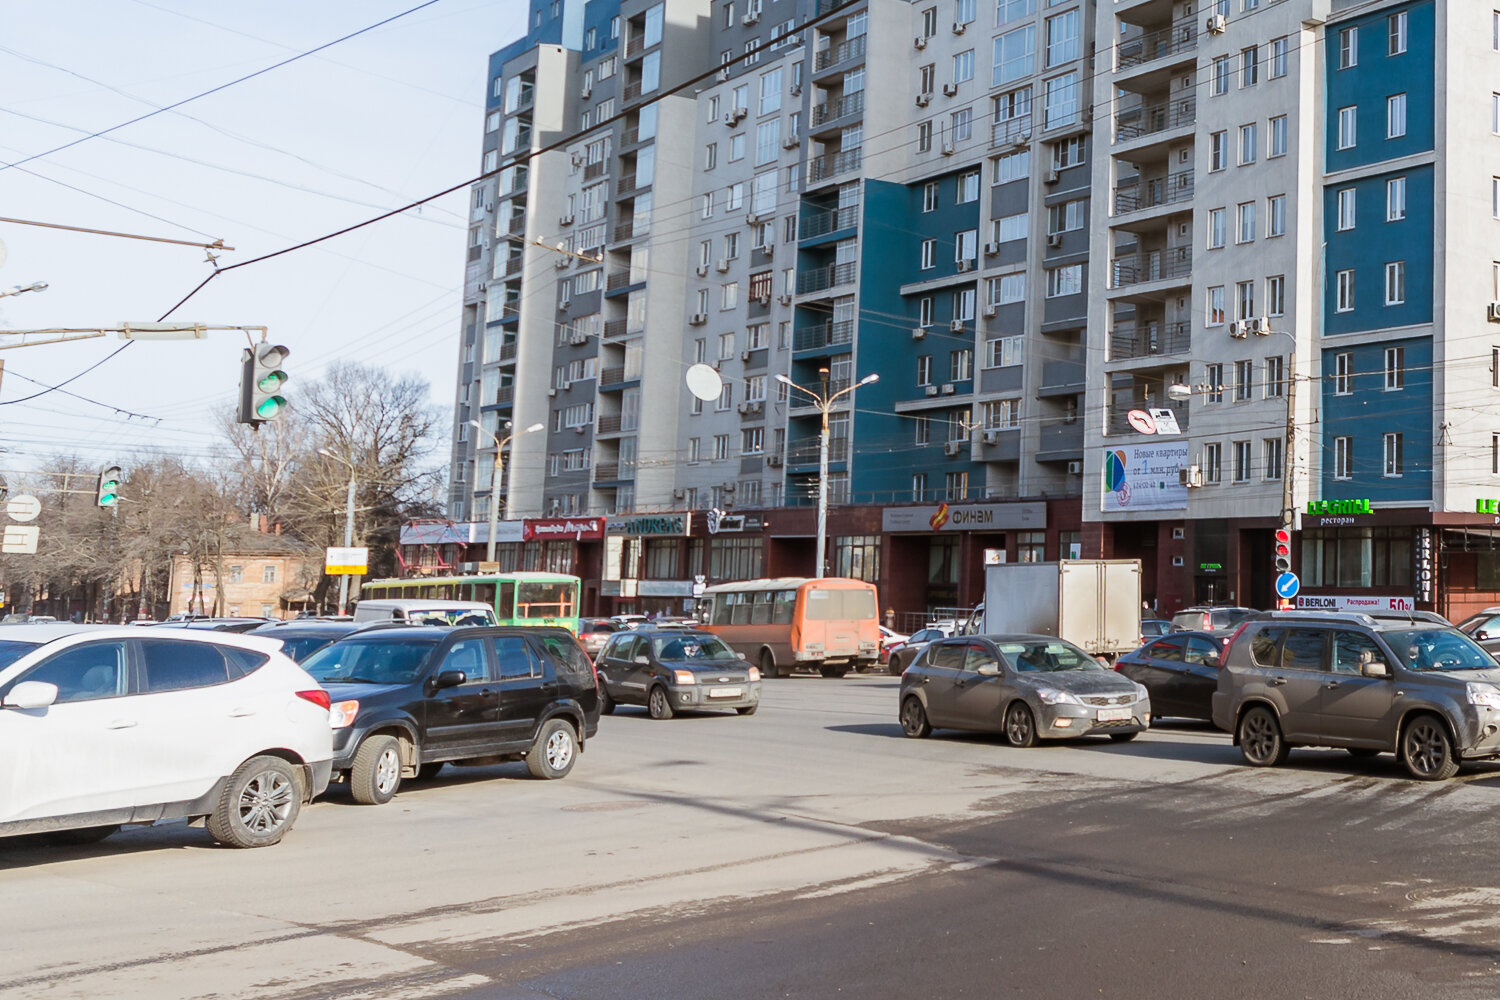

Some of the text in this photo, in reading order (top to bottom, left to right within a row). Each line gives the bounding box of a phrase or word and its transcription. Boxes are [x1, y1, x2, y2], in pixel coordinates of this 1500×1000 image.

[1134, 448, 1188, 459] Новые квартиры
[1142, 460, 1148, 474] 1
[1476, 499, 1497, 513] LE
[1320, 517, 1355, 525] ресторан
[1305, 598, 1336, 607] BERLONI
[1346, 598, 1380, 606] Распродажа!
